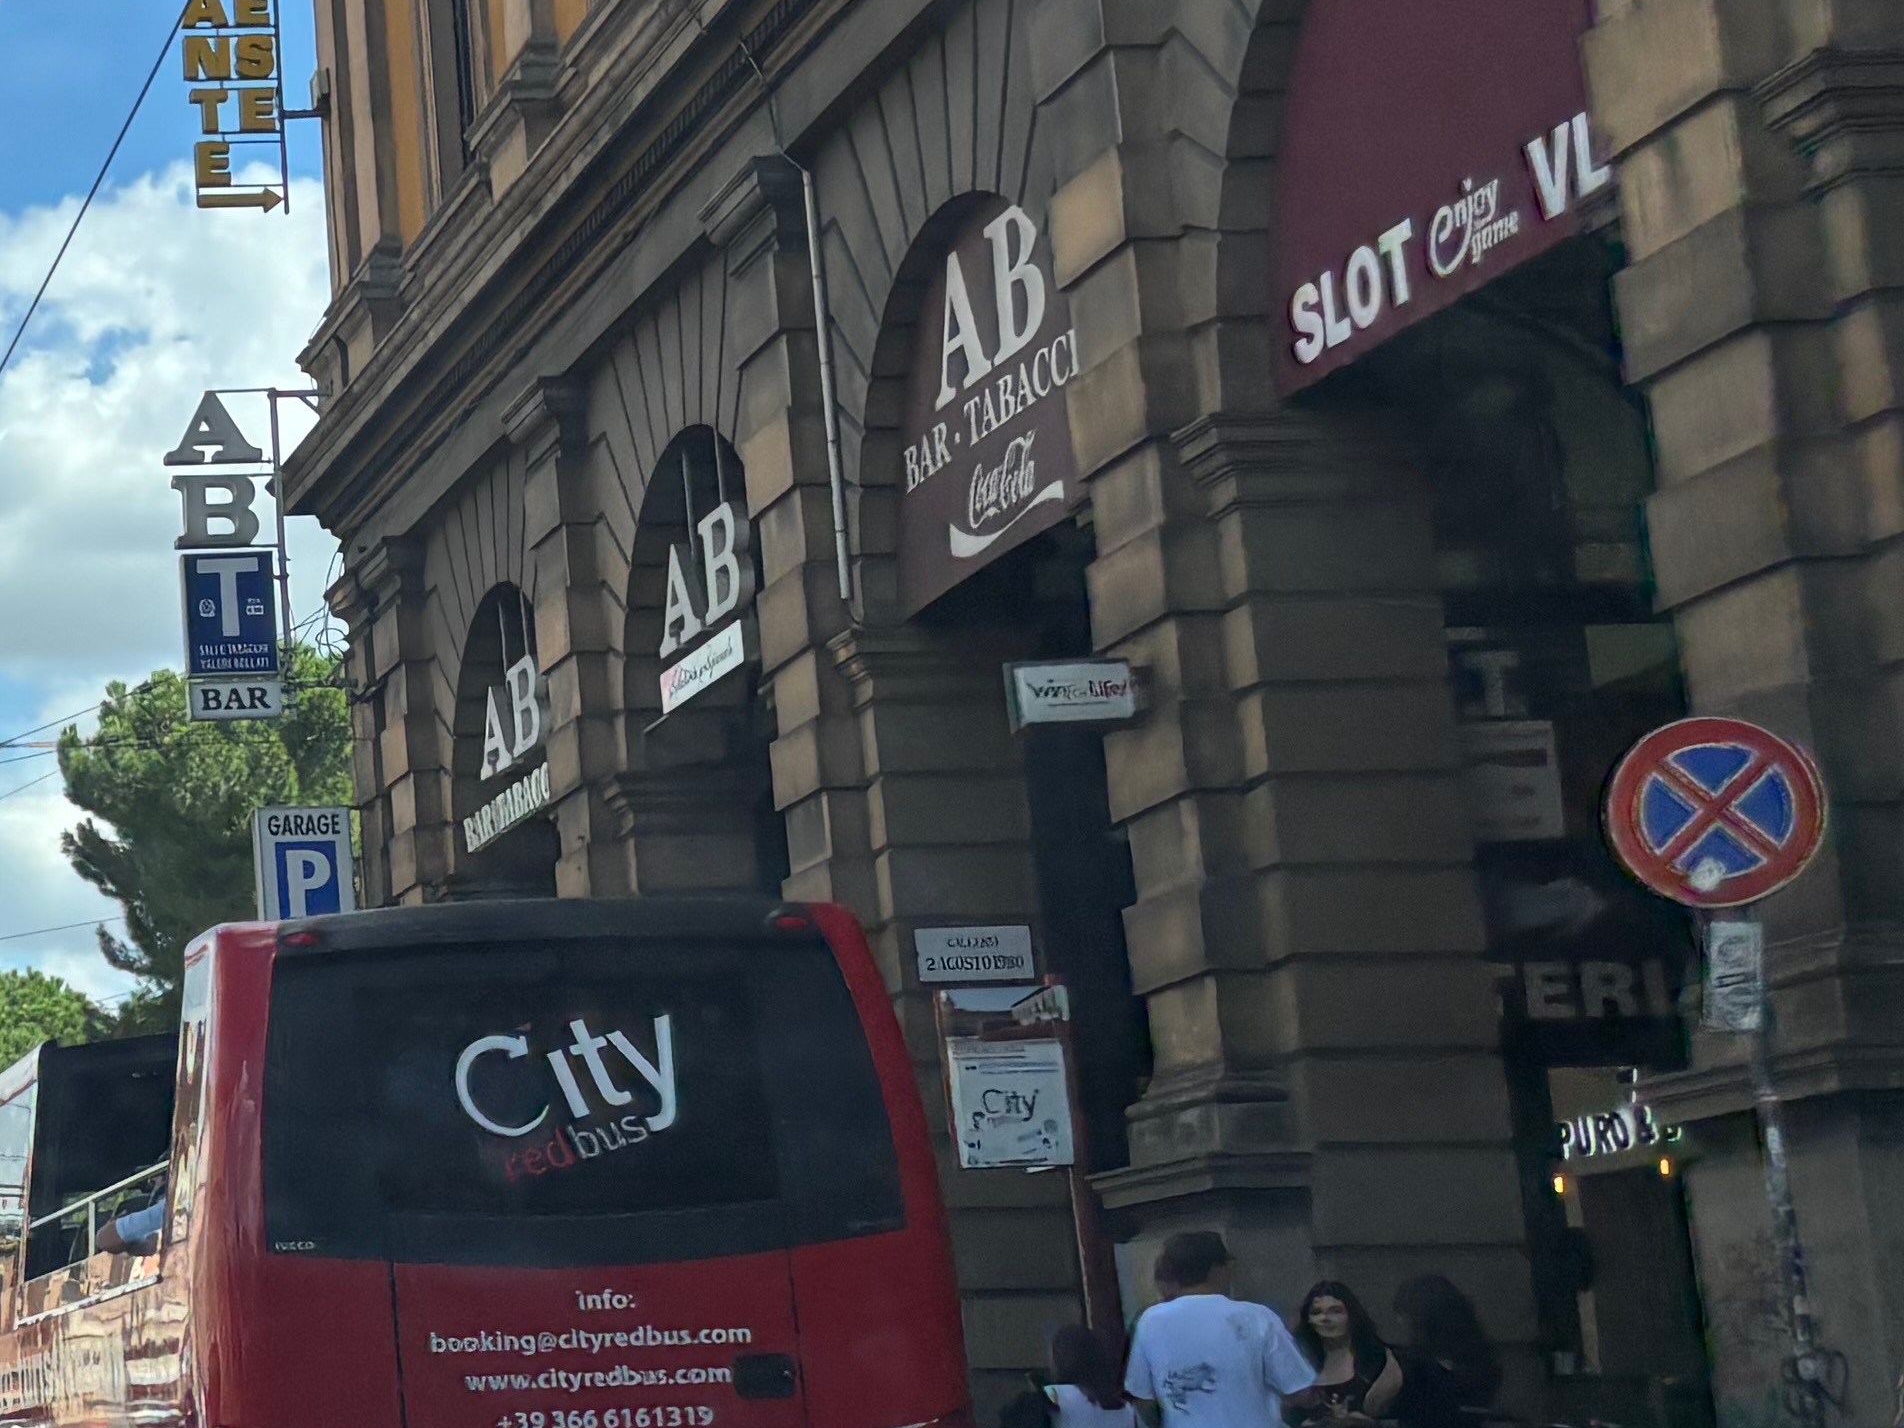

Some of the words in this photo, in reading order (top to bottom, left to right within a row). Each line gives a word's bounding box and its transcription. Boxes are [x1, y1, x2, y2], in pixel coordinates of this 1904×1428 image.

[934, 204, 1046, 412] AB
[1291, 218, 1412, 364] SLOT
[903, 421, 952, 496] BAR
[196, 556, 259, 637] T
[659, 501, 741, 659] AB
[200, 686, 272, 711] BAR
[480, 653, 542, 780] AB
[267, 814, 342, 836] GARAGE
[285, 849, 332, 919] P
[455, 1014, 677, 1138] City
[504, 1115, 648, 1183] redbus
[575, 1288, 637, 1311] info:
[429, 1324, 753, 1356] booking@cityredbus.com
[464, 1364, 734, 1393] www.cityredbus.com
[603, 1405, 715, 1428] 6161319
